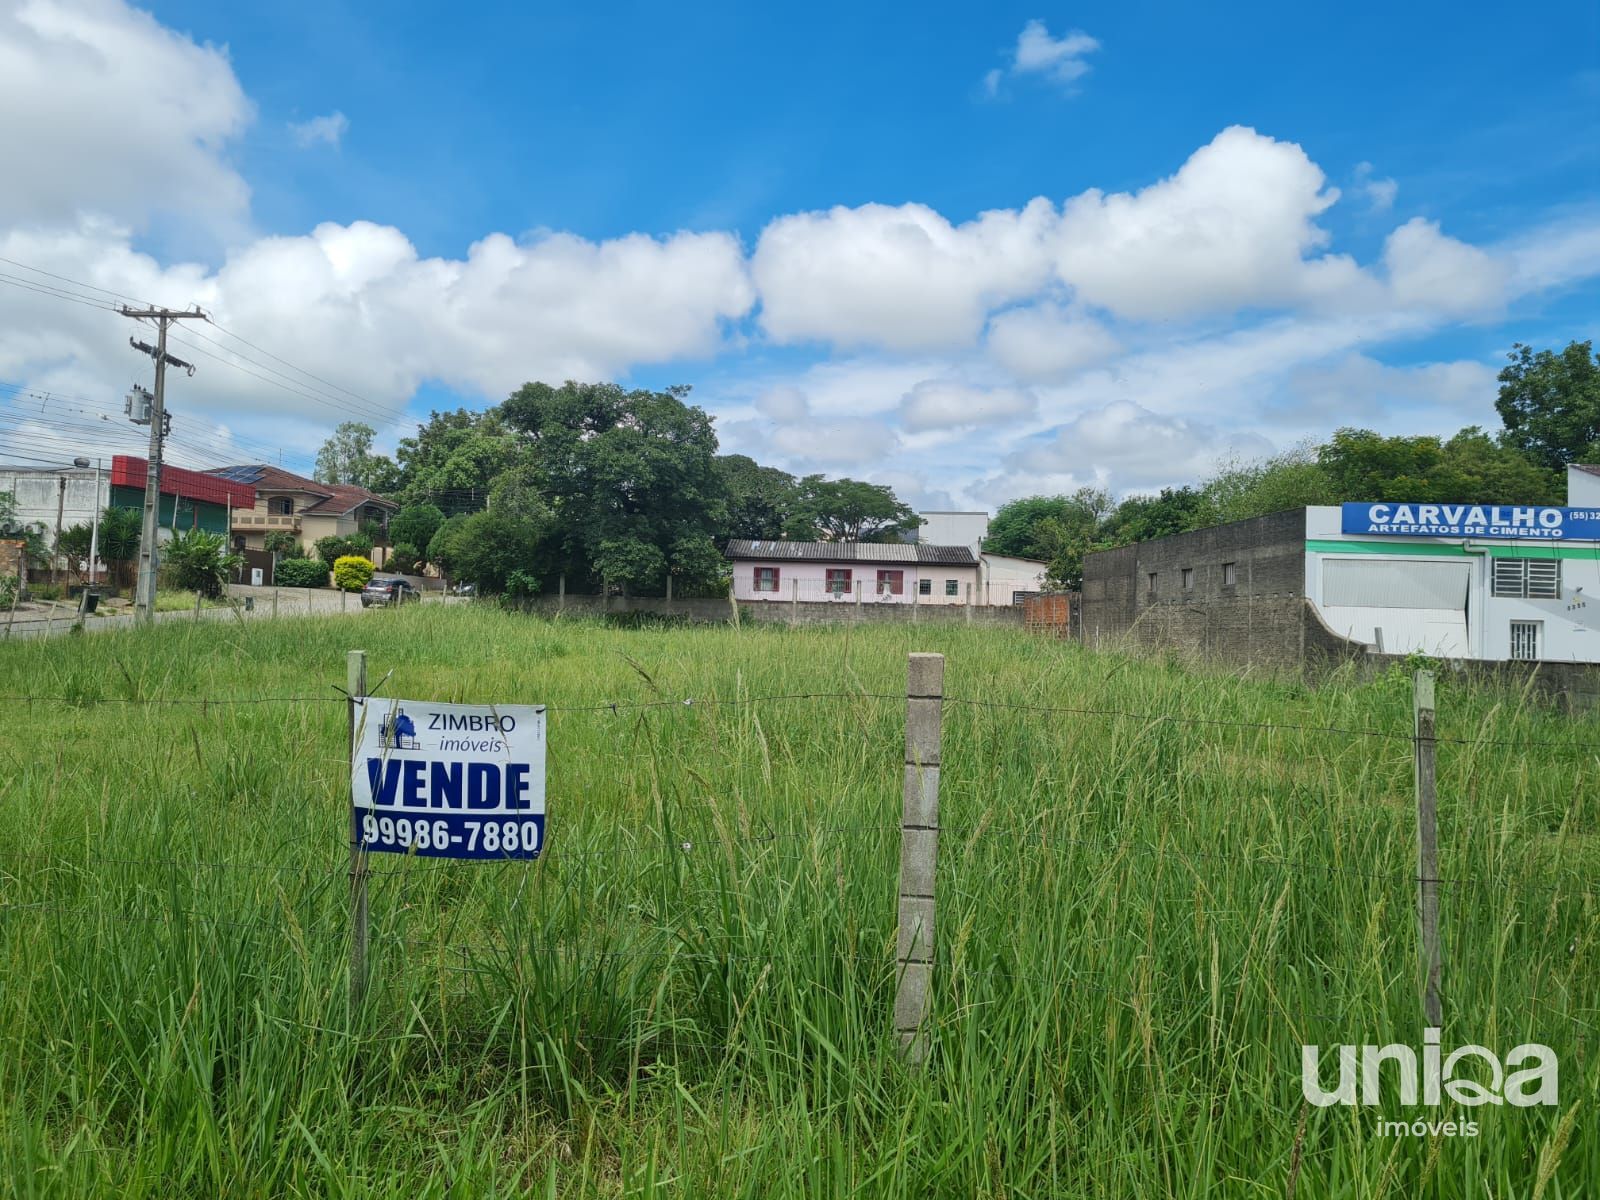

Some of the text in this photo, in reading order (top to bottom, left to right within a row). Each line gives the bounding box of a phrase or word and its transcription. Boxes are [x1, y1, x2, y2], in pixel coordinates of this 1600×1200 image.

[1368, 504, 1563, 528] CARVALHO
[1367, 524, 1563, 537] ARTEFATOS DE CIMENTO
[428, 713, 516, 733] ZIMBRO
[440, 735, 502, 753] imóveis
[367, 757, 531, 810] VENDE
[362, 814, 538, 852] 99986-7880
